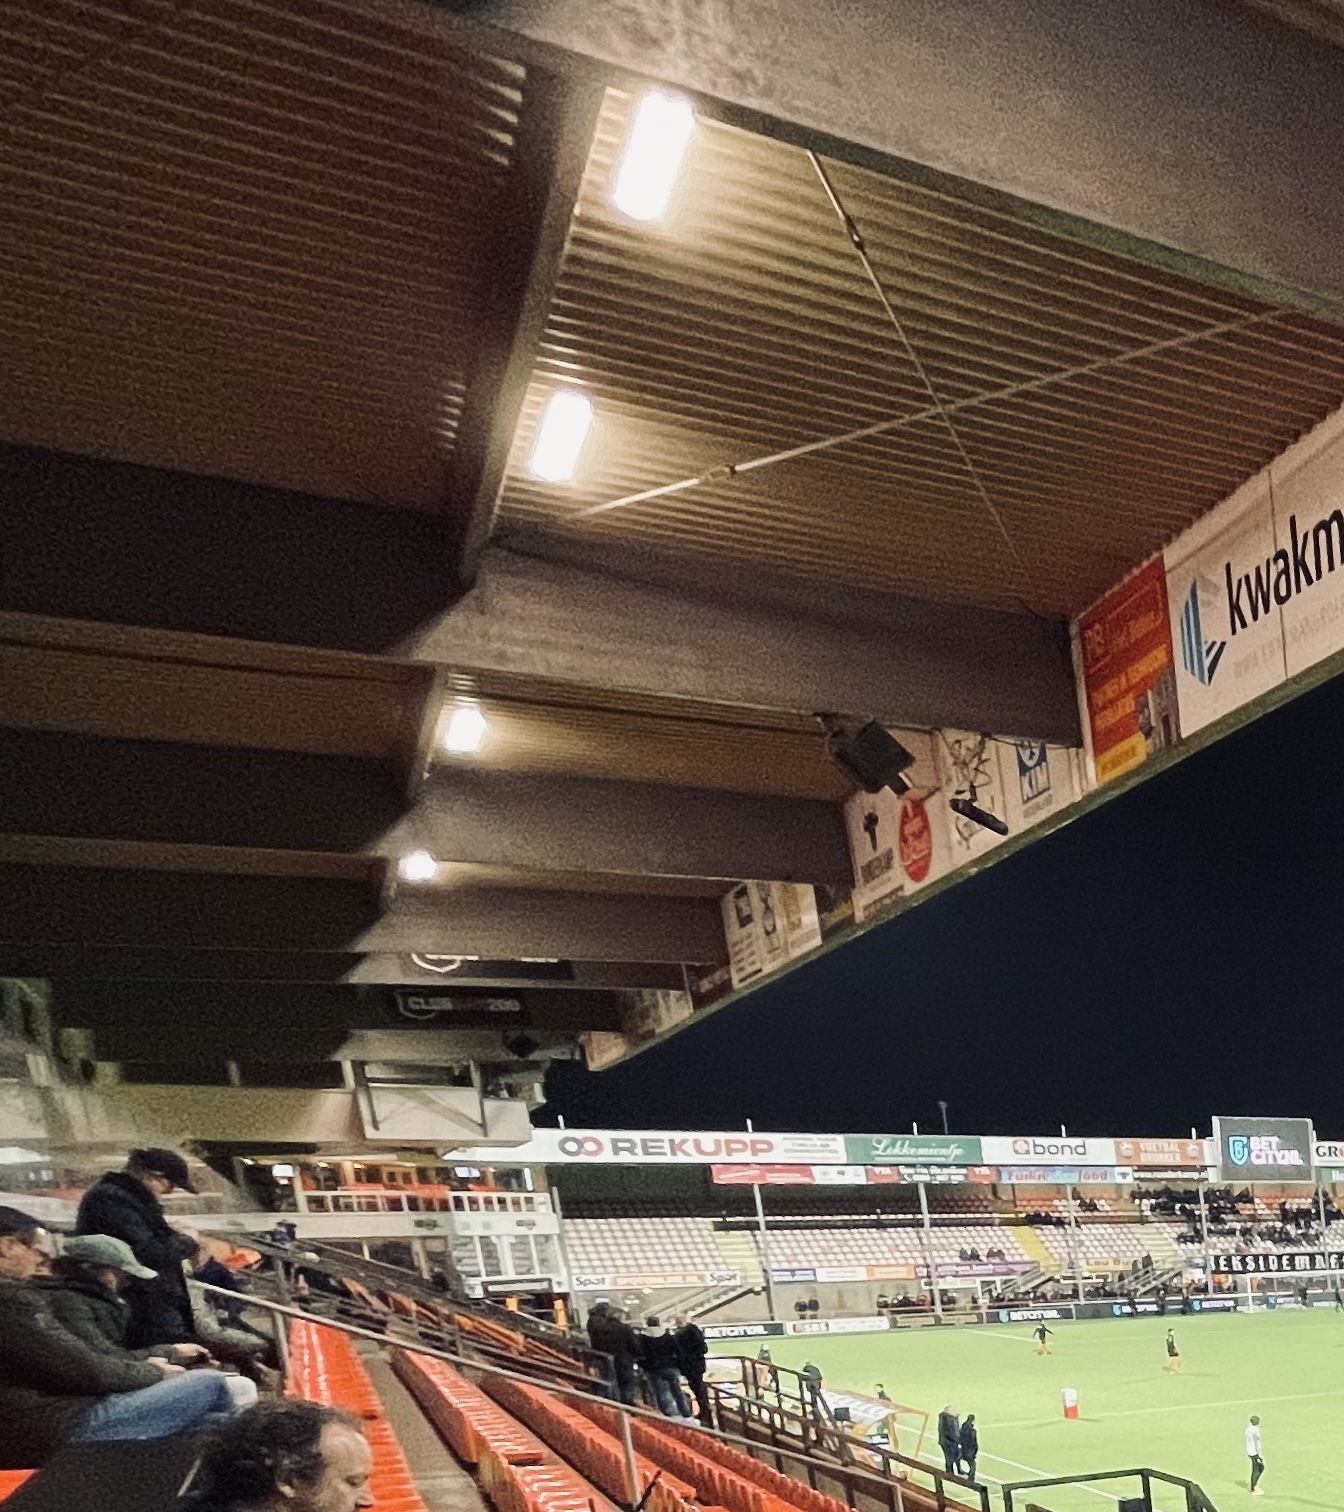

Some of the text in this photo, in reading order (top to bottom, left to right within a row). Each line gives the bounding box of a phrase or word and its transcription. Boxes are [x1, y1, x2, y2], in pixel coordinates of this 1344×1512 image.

[609, 1136, 774, 1158] REKUPP
[1032, 1139, 1088, 1156] bond
[1249, 1135, 1281, 1151] BET
